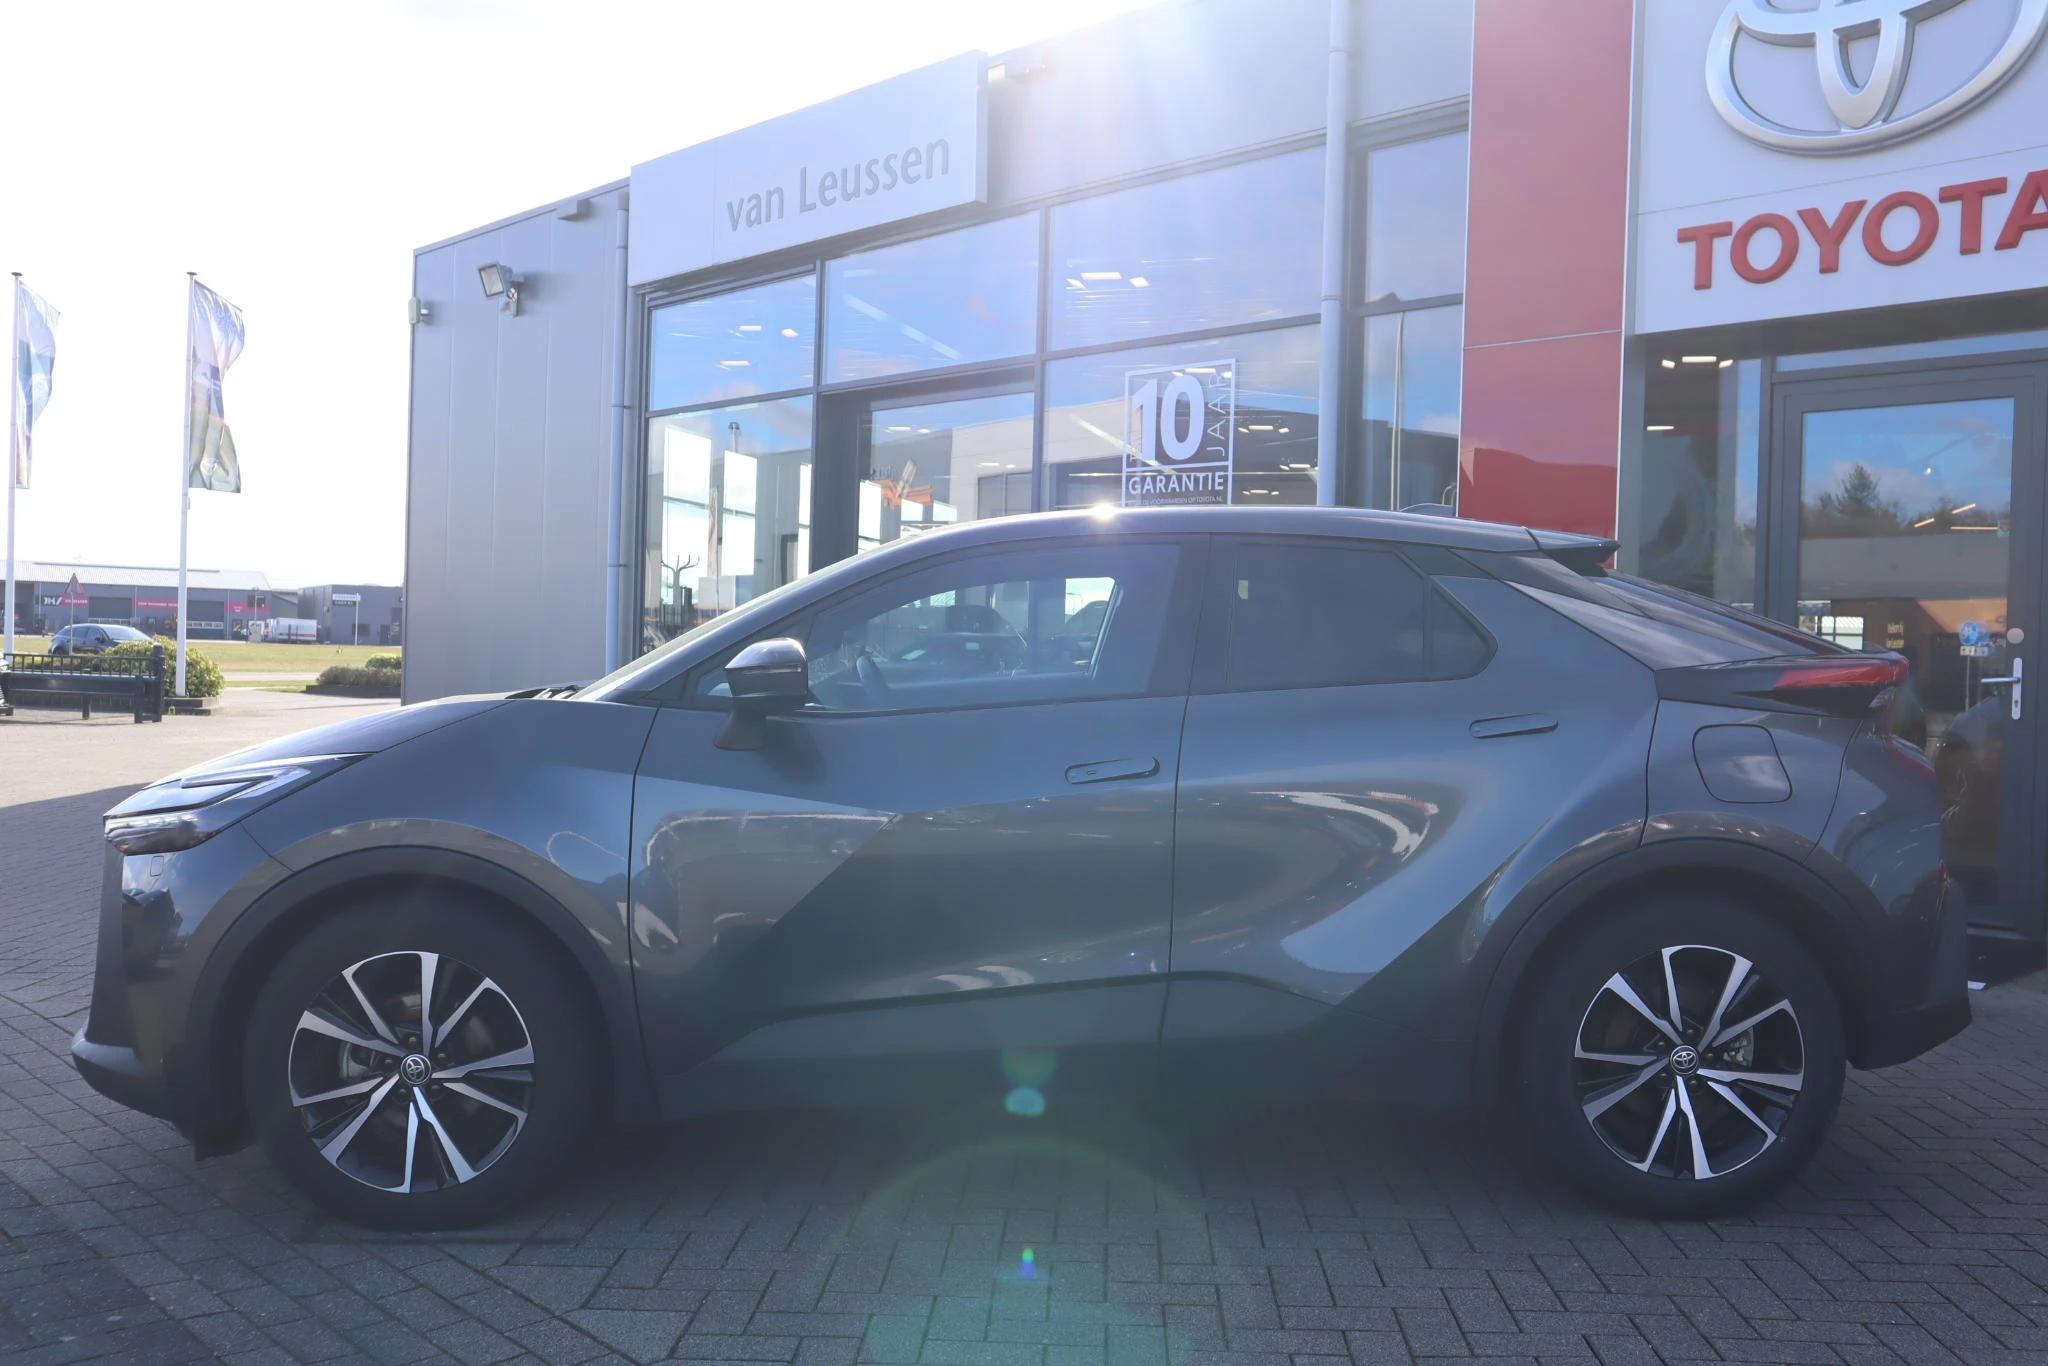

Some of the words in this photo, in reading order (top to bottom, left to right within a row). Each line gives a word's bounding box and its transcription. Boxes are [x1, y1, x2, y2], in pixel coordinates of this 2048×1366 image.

[726, 185, 785, 232] van
[799, 138, 950, 214] Leussen
[1676, 169, 2048, 291] TOYOTA
[1132, 374, 1205, 462] 10
[1206, 373, 1228, 457] JAAR
[1128, 472, 1224, 495] GARANTIE
